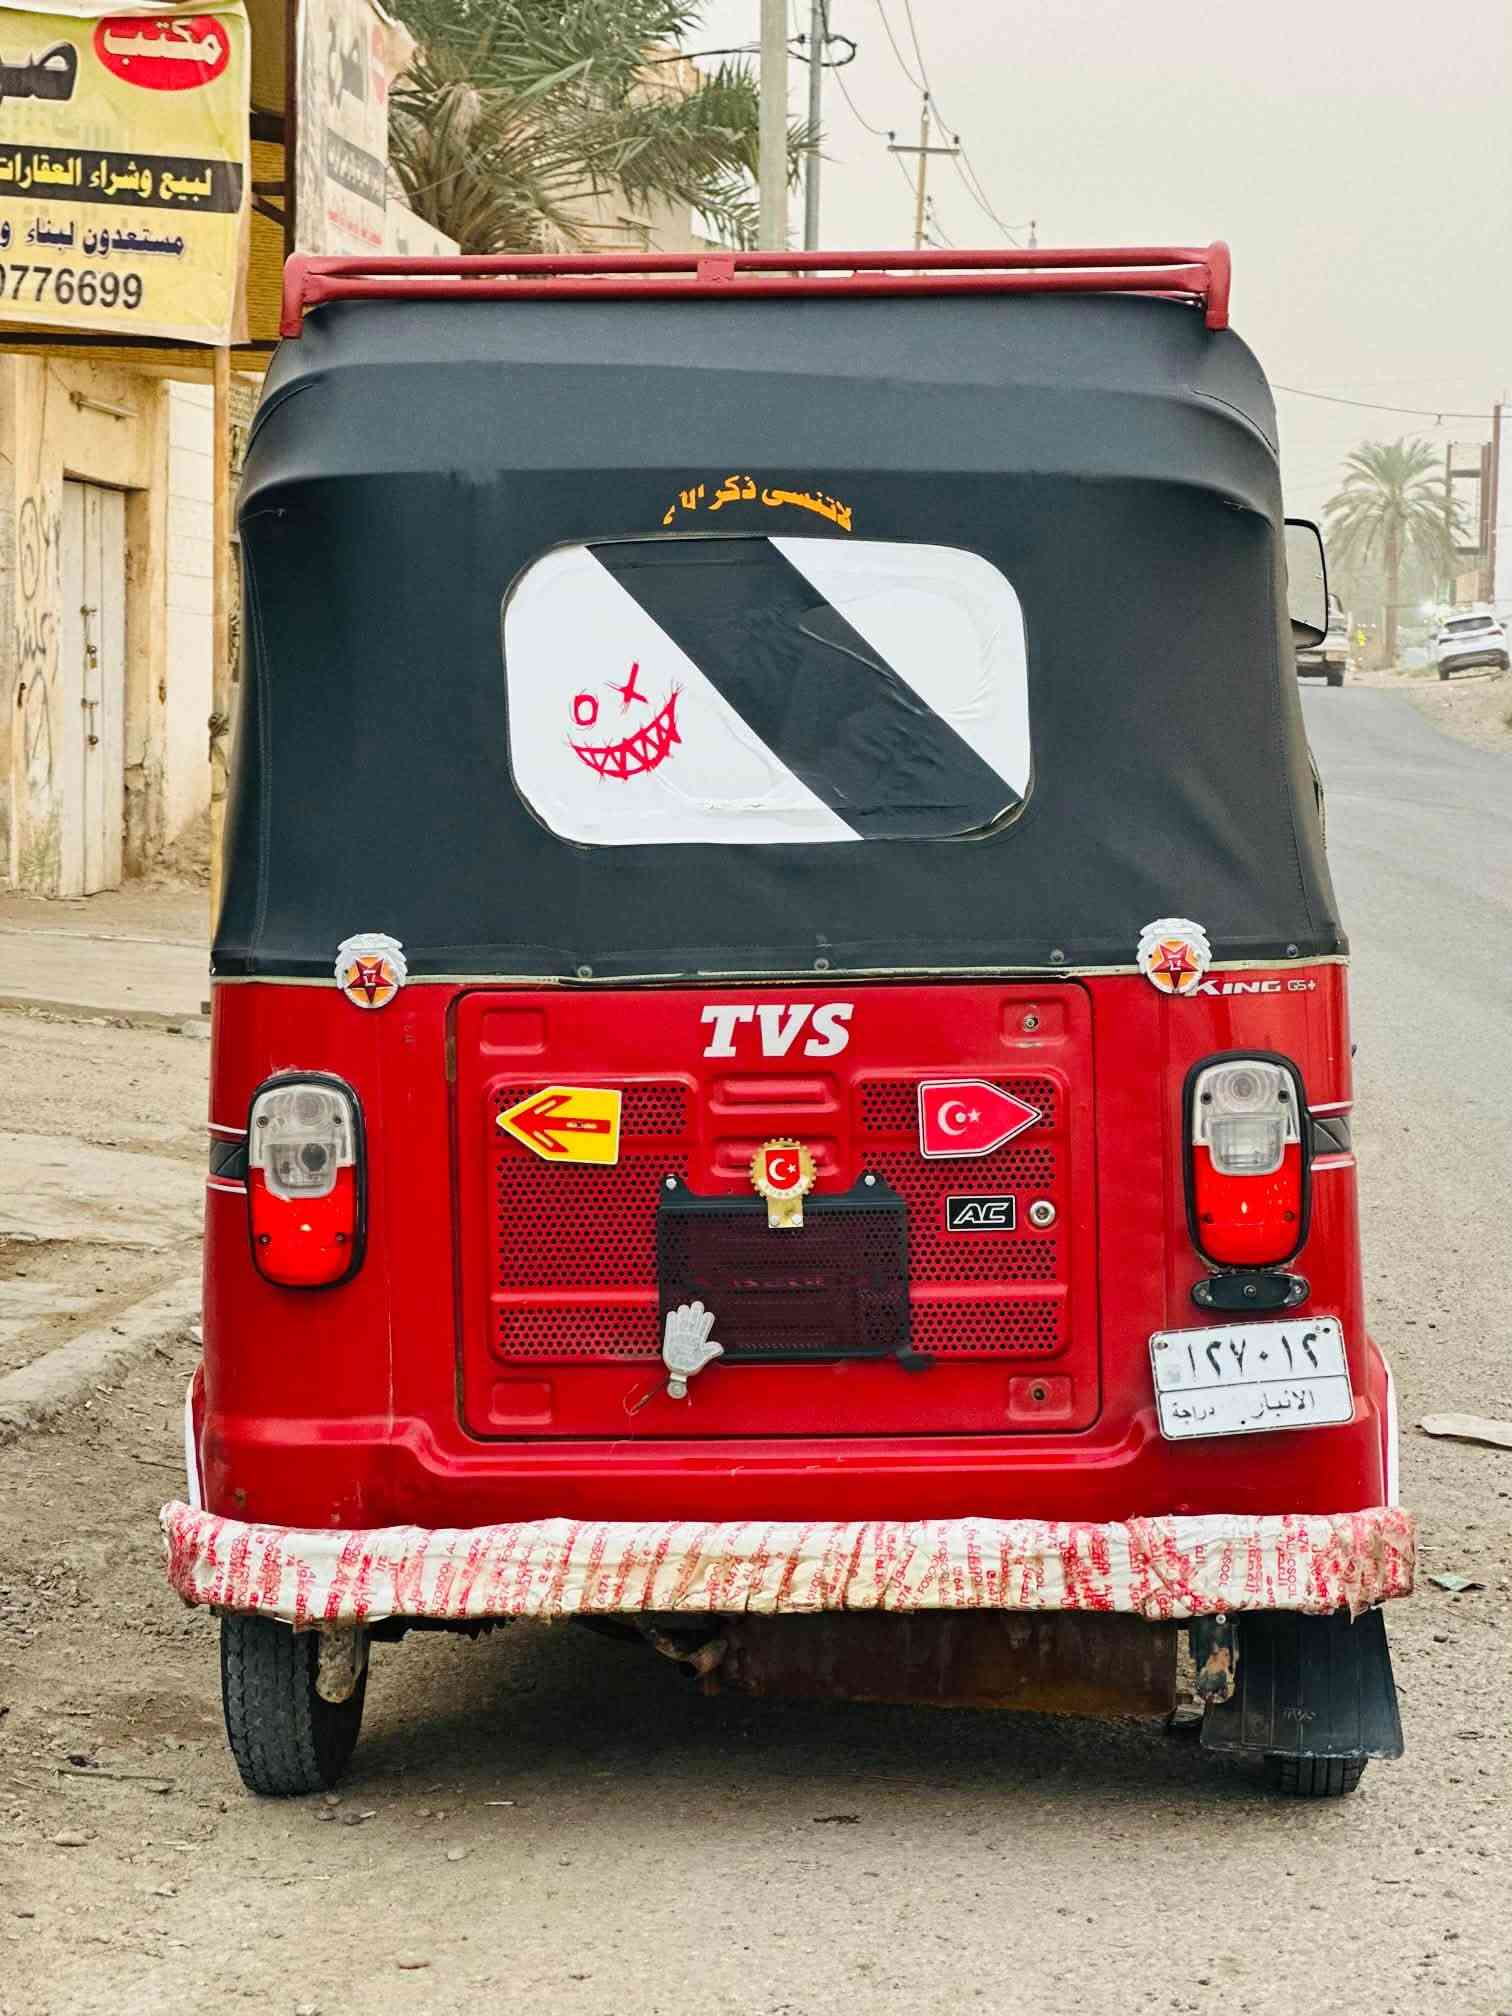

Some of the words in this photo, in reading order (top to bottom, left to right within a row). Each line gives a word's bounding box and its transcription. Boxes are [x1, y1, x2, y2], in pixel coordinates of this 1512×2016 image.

[103, 18, 223, 66] مكتب
[88, 159, 152, 199] وشراء
[159, 166, 212, 202] لبيع
[26, 217, 75, 251] لبناء
[82, 228, 185, 255] مستعدون
[0, 262, 143, 310] 776699
[708, 475, 757, 511] ذكر
[1184, 979, 1281, 997] KING
[701, 1003, 854, 1058] TVS
[953, 1202, 1010, 1225] AC
